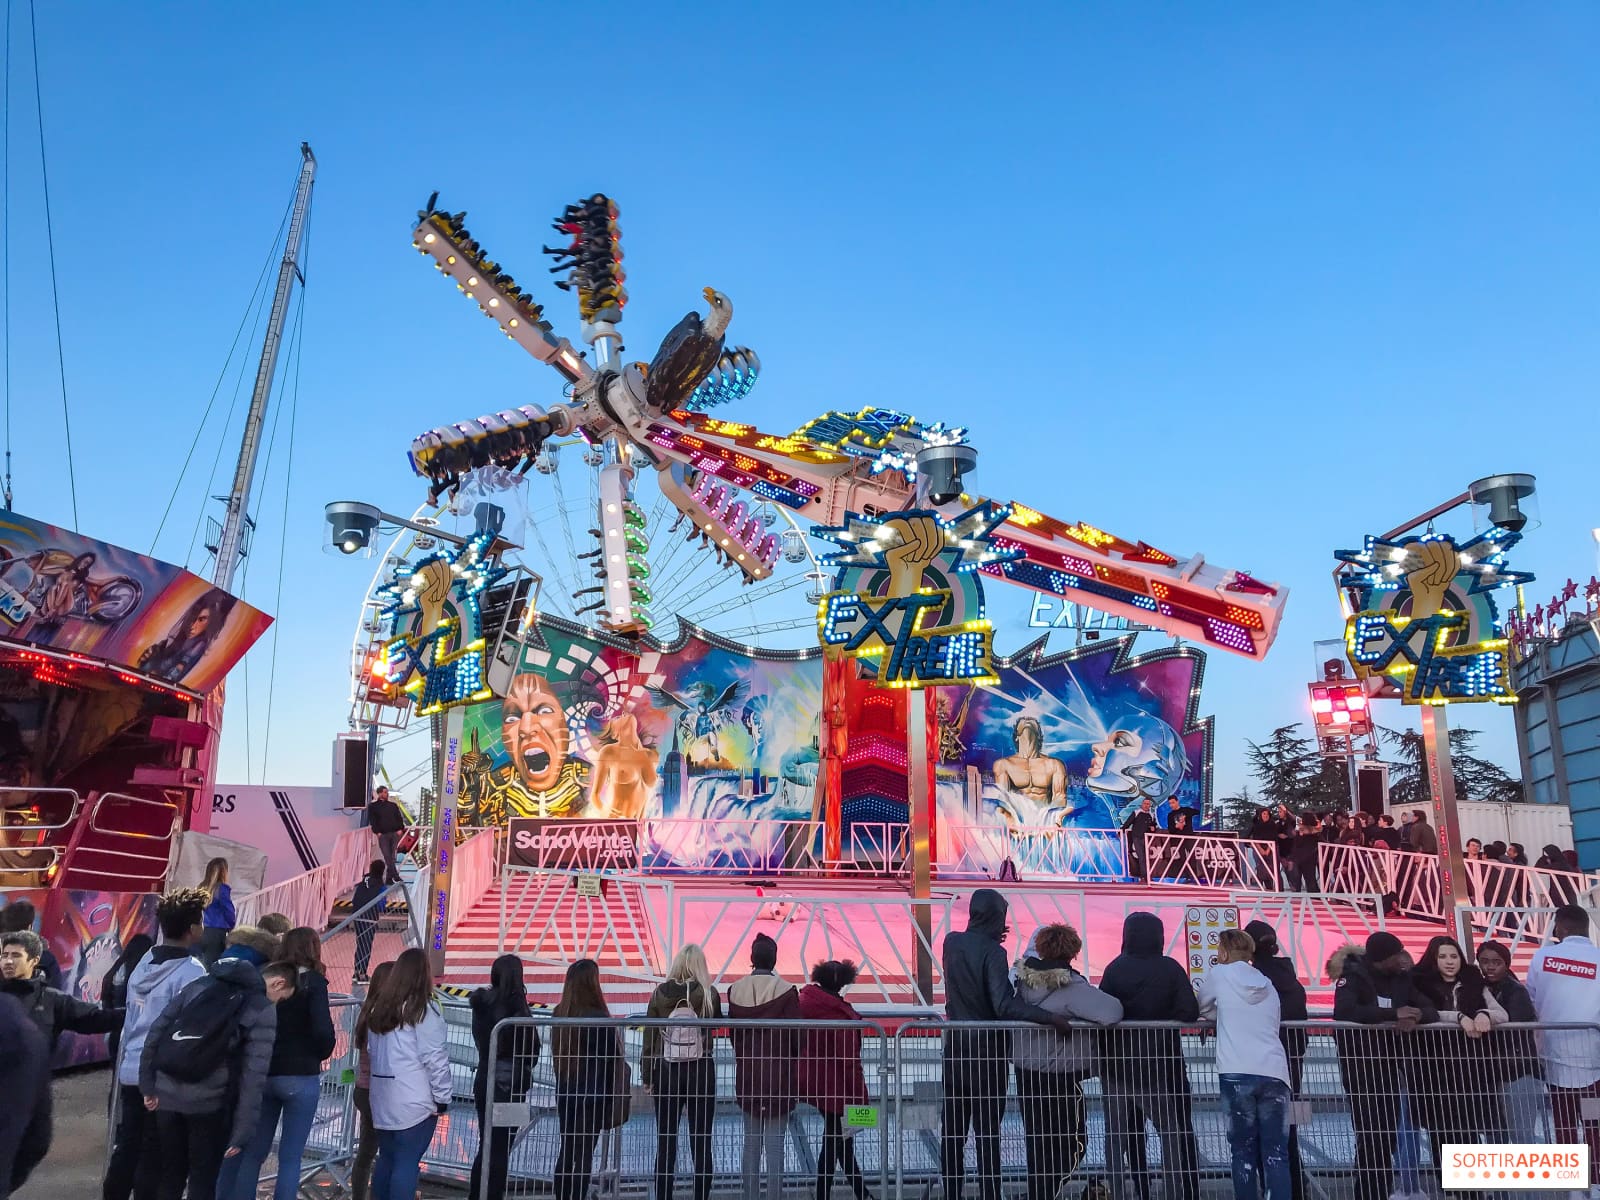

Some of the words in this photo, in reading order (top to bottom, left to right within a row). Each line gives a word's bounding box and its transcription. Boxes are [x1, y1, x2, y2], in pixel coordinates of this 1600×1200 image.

[445, 737, 458, 794] EXTREME
[515, 829, 632, 849] SonoVente
[1545, 958, 1595, 975] Supreme
